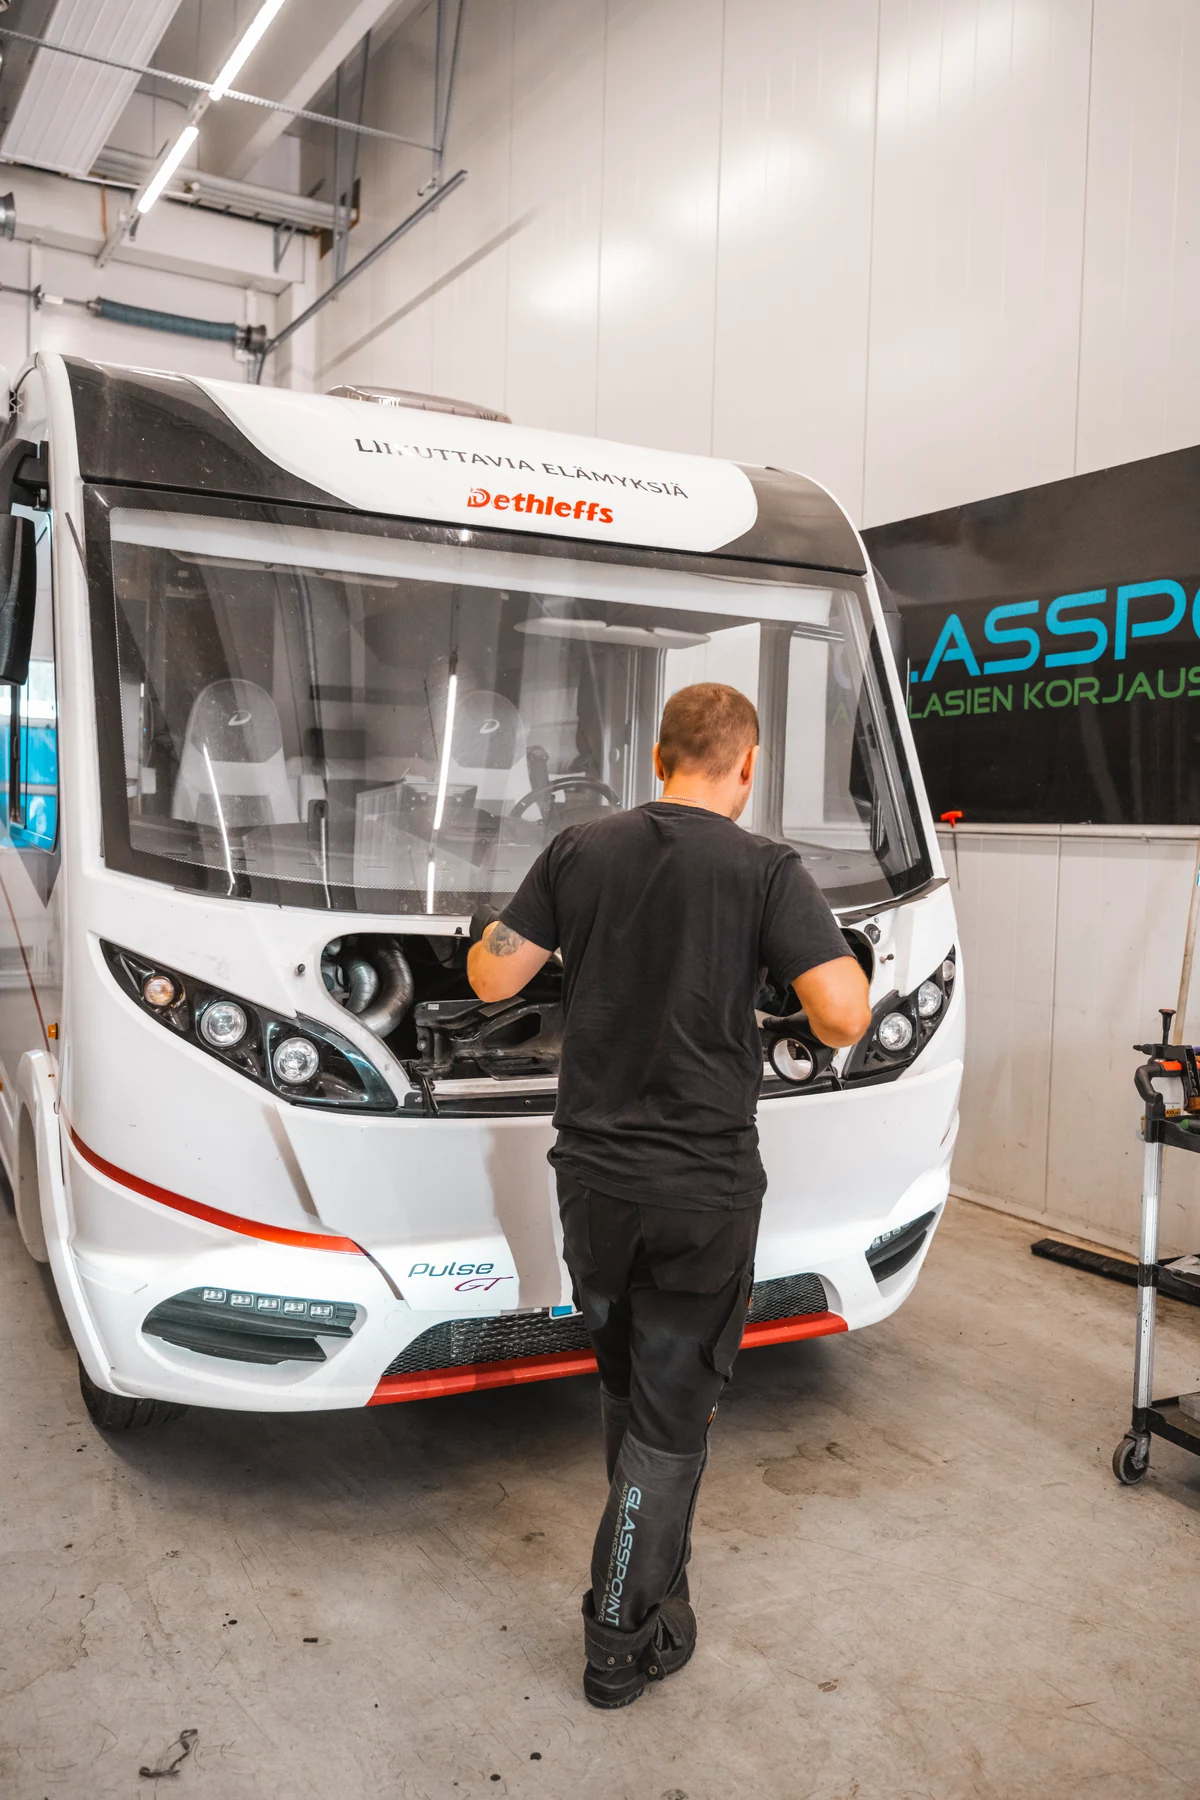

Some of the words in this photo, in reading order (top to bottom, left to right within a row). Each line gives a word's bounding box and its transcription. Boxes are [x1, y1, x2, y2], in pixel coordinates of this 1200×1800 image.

[541, 462, 689, 499] ELÄMYKSIÄ
[466, 487, 614, 524] Dethleffs
[910, 578, 1200, 683] ASSP
[454, 1276, 514, 1292] GT
[605, 1486, 642, 1627] GLASSPOINT
